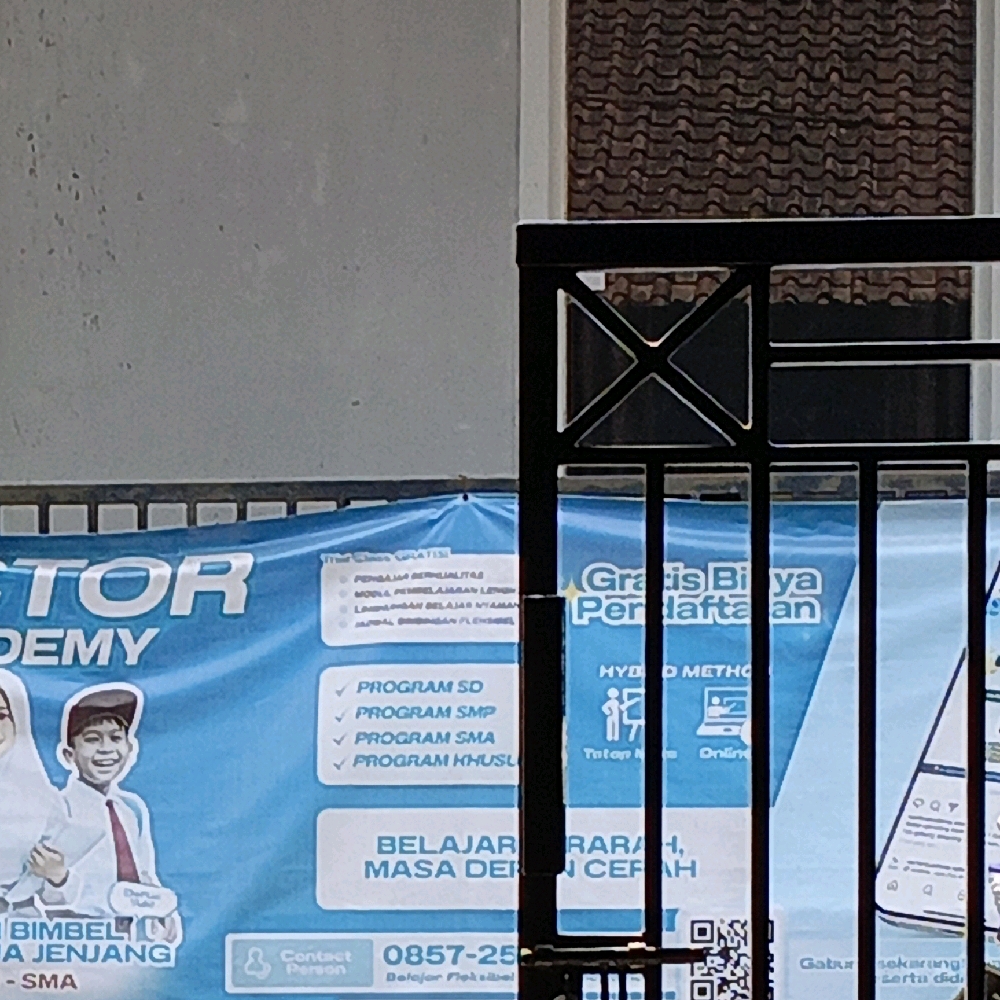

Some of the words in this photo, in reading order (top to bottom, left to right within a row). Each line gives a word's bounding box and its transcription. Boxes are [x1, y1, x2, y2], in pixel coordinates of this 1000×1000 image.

[586, 567, 703, 592] Grais
[712, 567, 819, 598] Biya
[600, 664, 678, 678] HYBD
[681, 664, 752, 678] METHO
[356, 680, 454, 694] PROGRAM
[457, 680, 484, 694] SD
[355, 706, 452, 719] PROGRAM
[455, 705, 497, 719] SMP
[354, 731, 451, 745] PROGRAM
[454, 731, 496, 745] SMA
[352, 754, 449, 768] PROGRAM
[452, 753, 521, 768] KHUSU
[376, 835, 516, 855] BELAJAR
[364, 860, 457, 879] MASA
[583, 859, 697, 879] CERH
[9, 921, 126, 941] BIMBEL
[31, 942, 173, 962] JENJANG
[279, 949, 353, 964] Contact
[382, 944, 516, 967] 0857-25
[286, 964, 347, 977] Person
[20, 973, 78, 989] SMA
